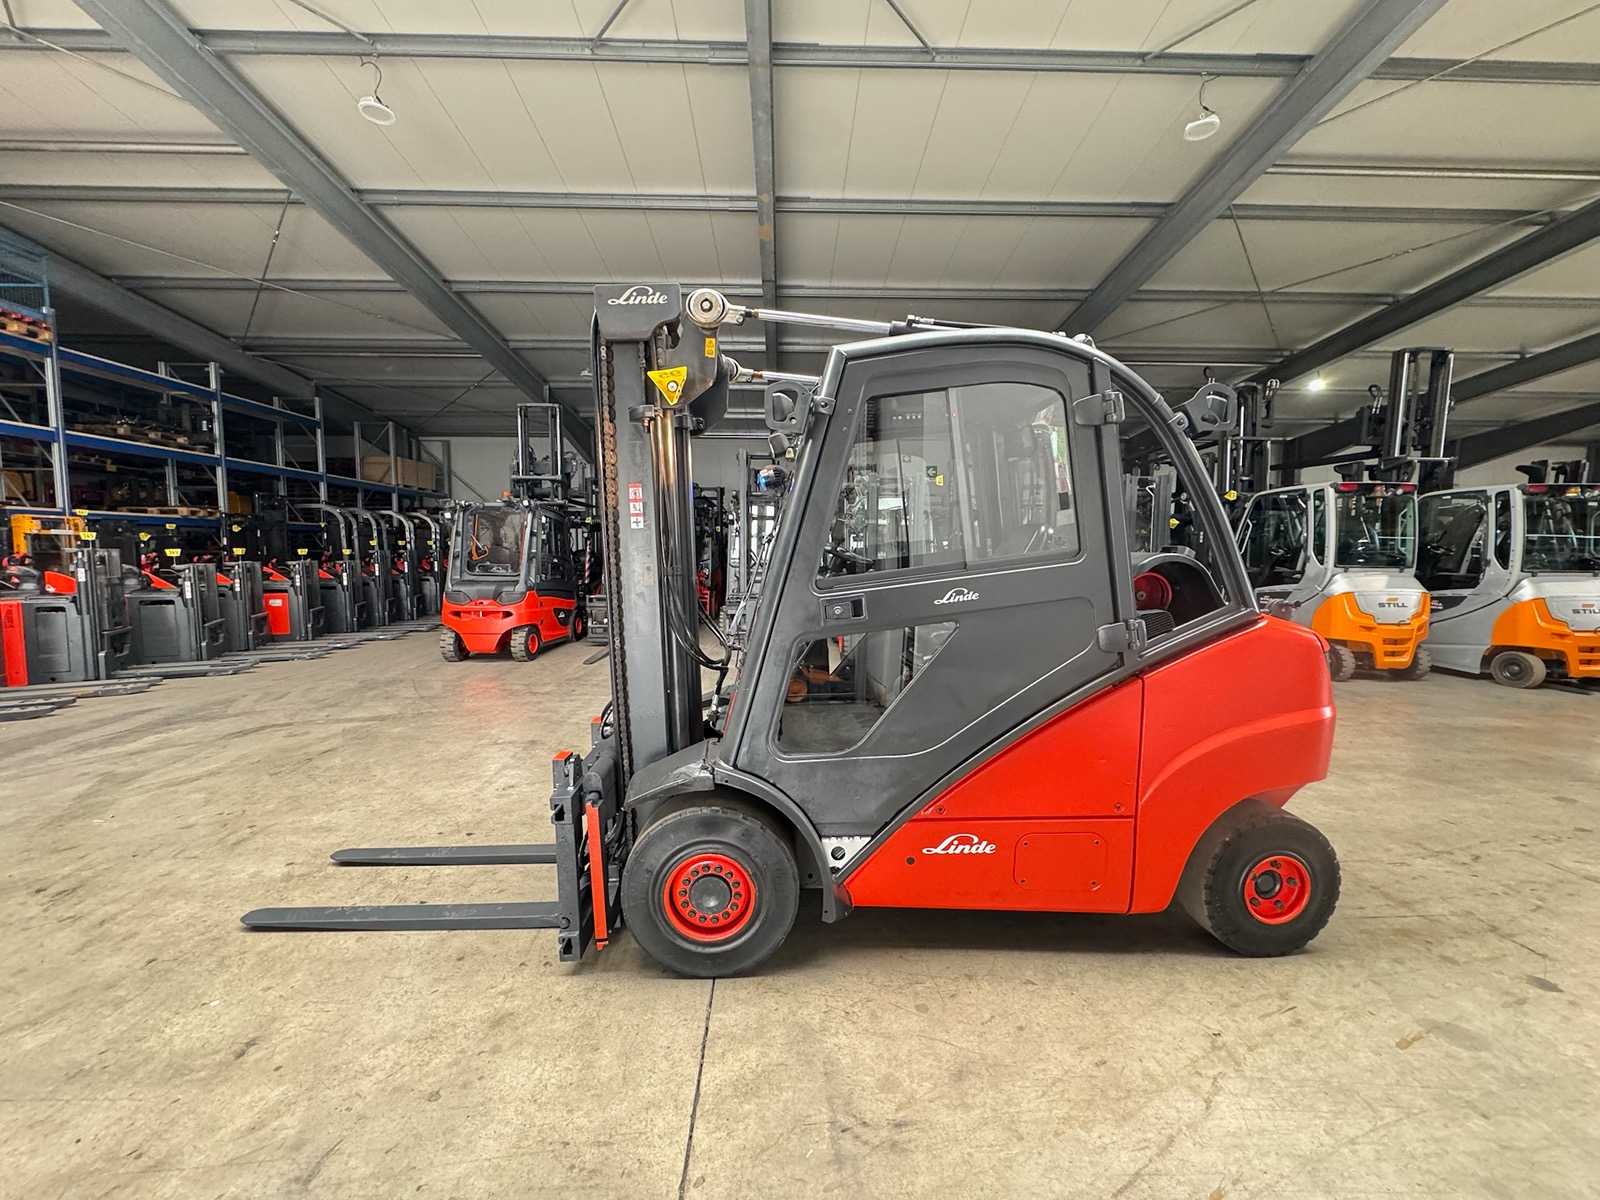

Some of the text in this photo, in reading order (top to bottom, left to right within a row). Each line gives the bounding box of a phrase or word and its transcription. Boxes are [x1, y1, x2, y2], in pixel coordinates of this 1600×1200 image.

[608, 286, 668, 305] Linde
[933, 587, 980, 604] Linde
[922, 833, 997, 854] Linde
